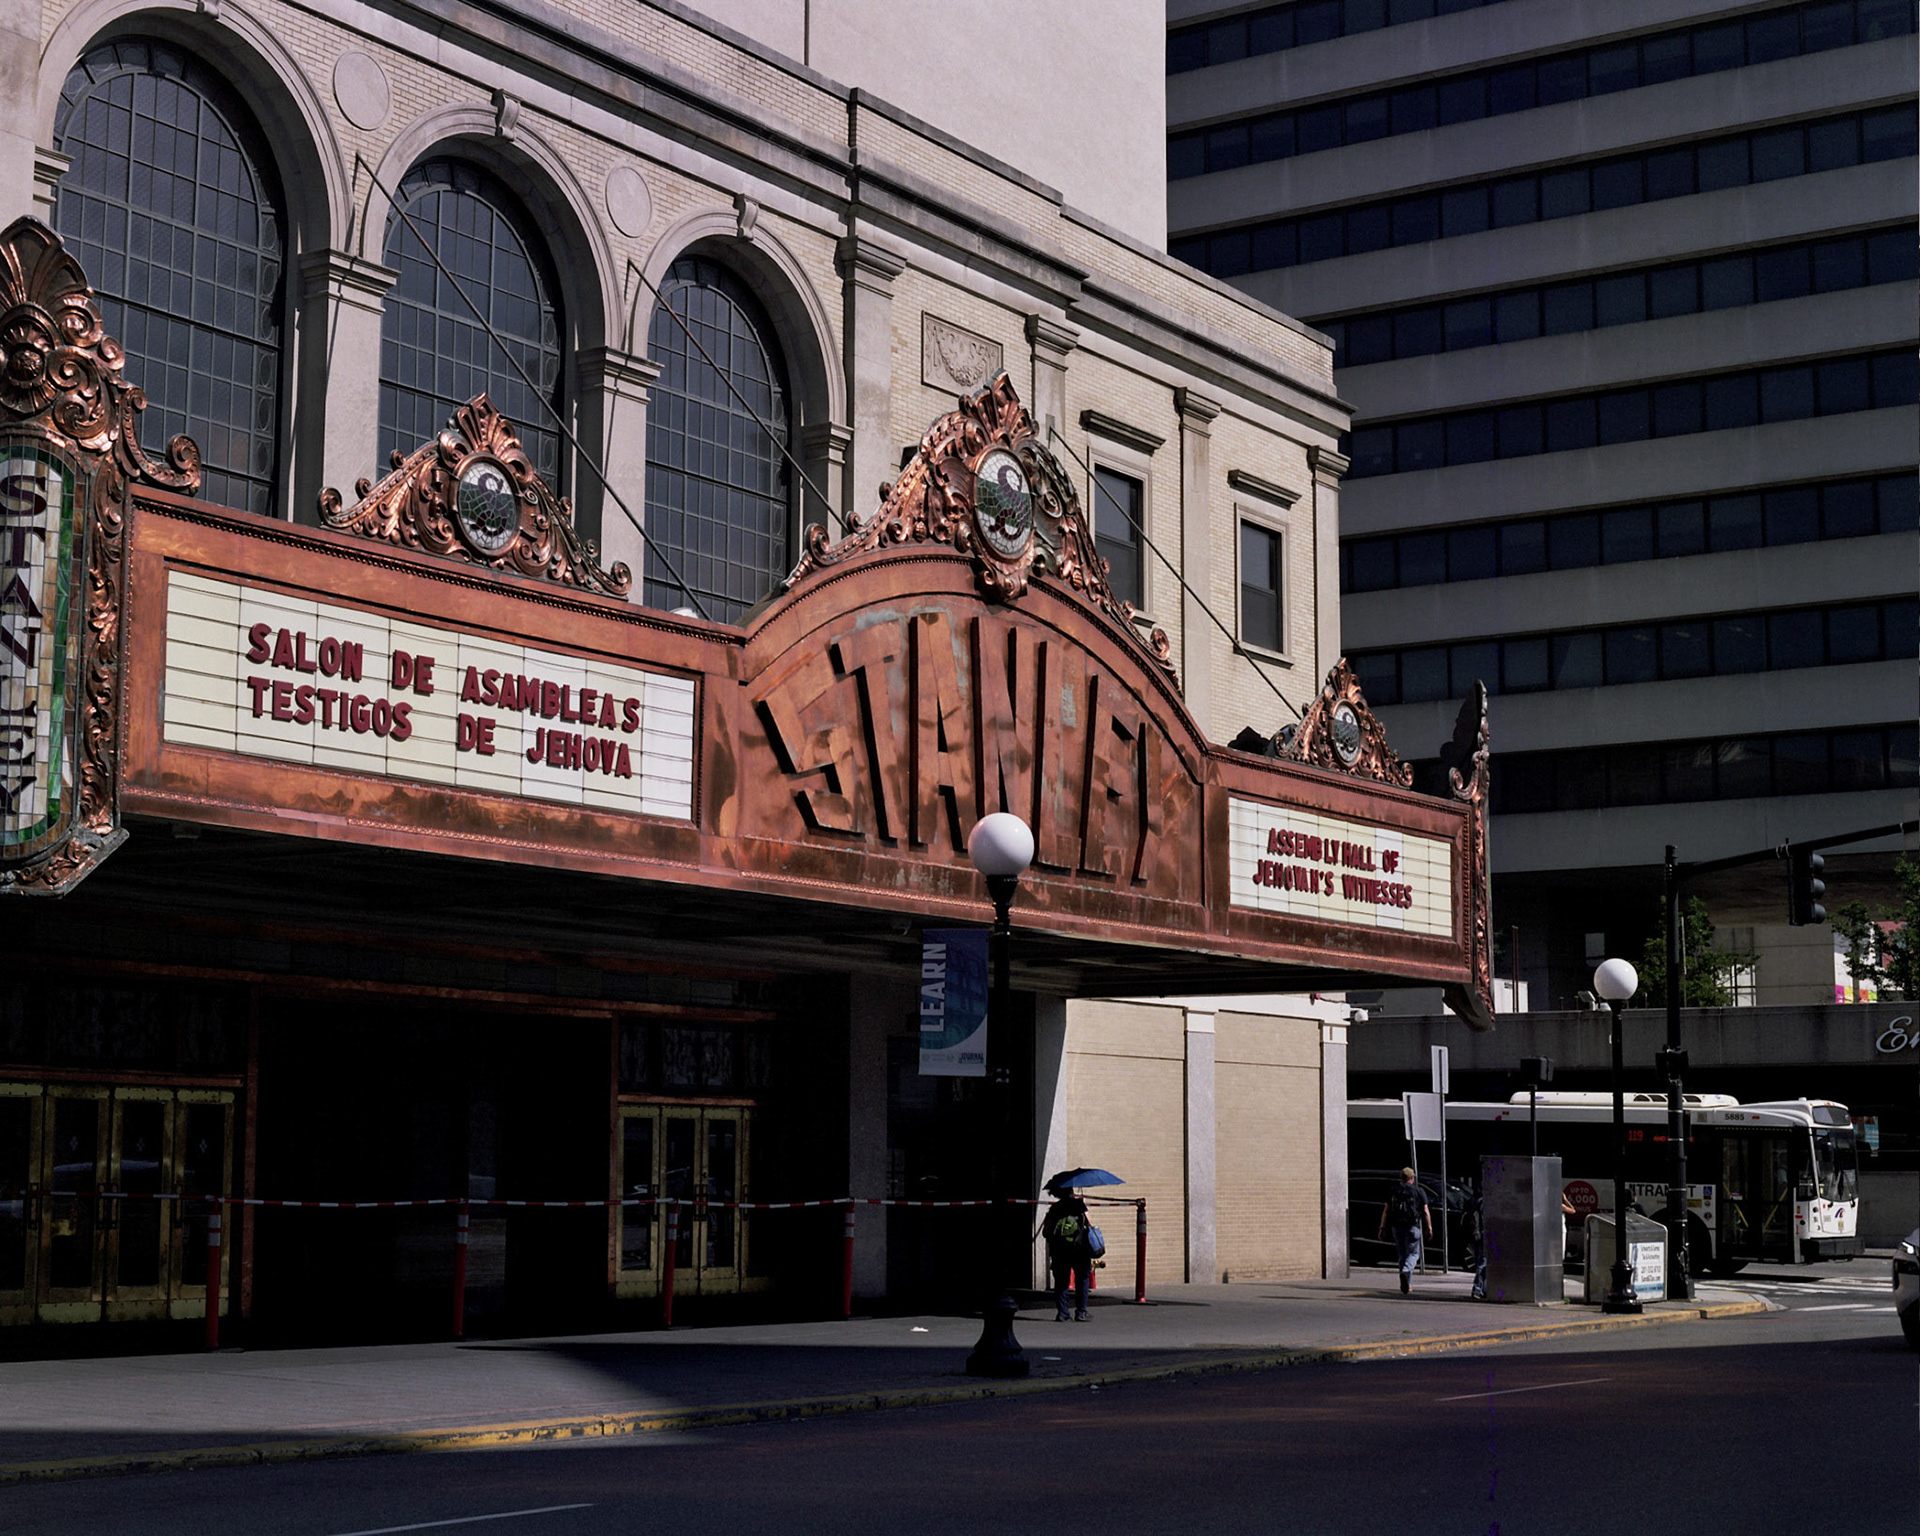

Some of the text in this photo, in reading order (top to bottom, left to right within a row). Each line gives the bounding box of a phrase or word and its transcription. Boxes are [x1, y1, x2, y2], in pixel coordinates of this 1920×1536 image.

[246, 623, 640, 733] SALON DE ASAMBLEAS
[247, 676, 632, 778] TESTIGOS DE JEHOVA
[753, 611, 1164, 887] STANLEY
[1253, 859, 1413, 909] JEHOVAH'S WITNESSES
[1267, 828, 1400, 874] ASSEMBLY HALL OF
[920, 943, 947, 1032] LEARN
[1628, 1130, 1644, 1142] 119
[1724, 1113, 1745, 1121] 5885
